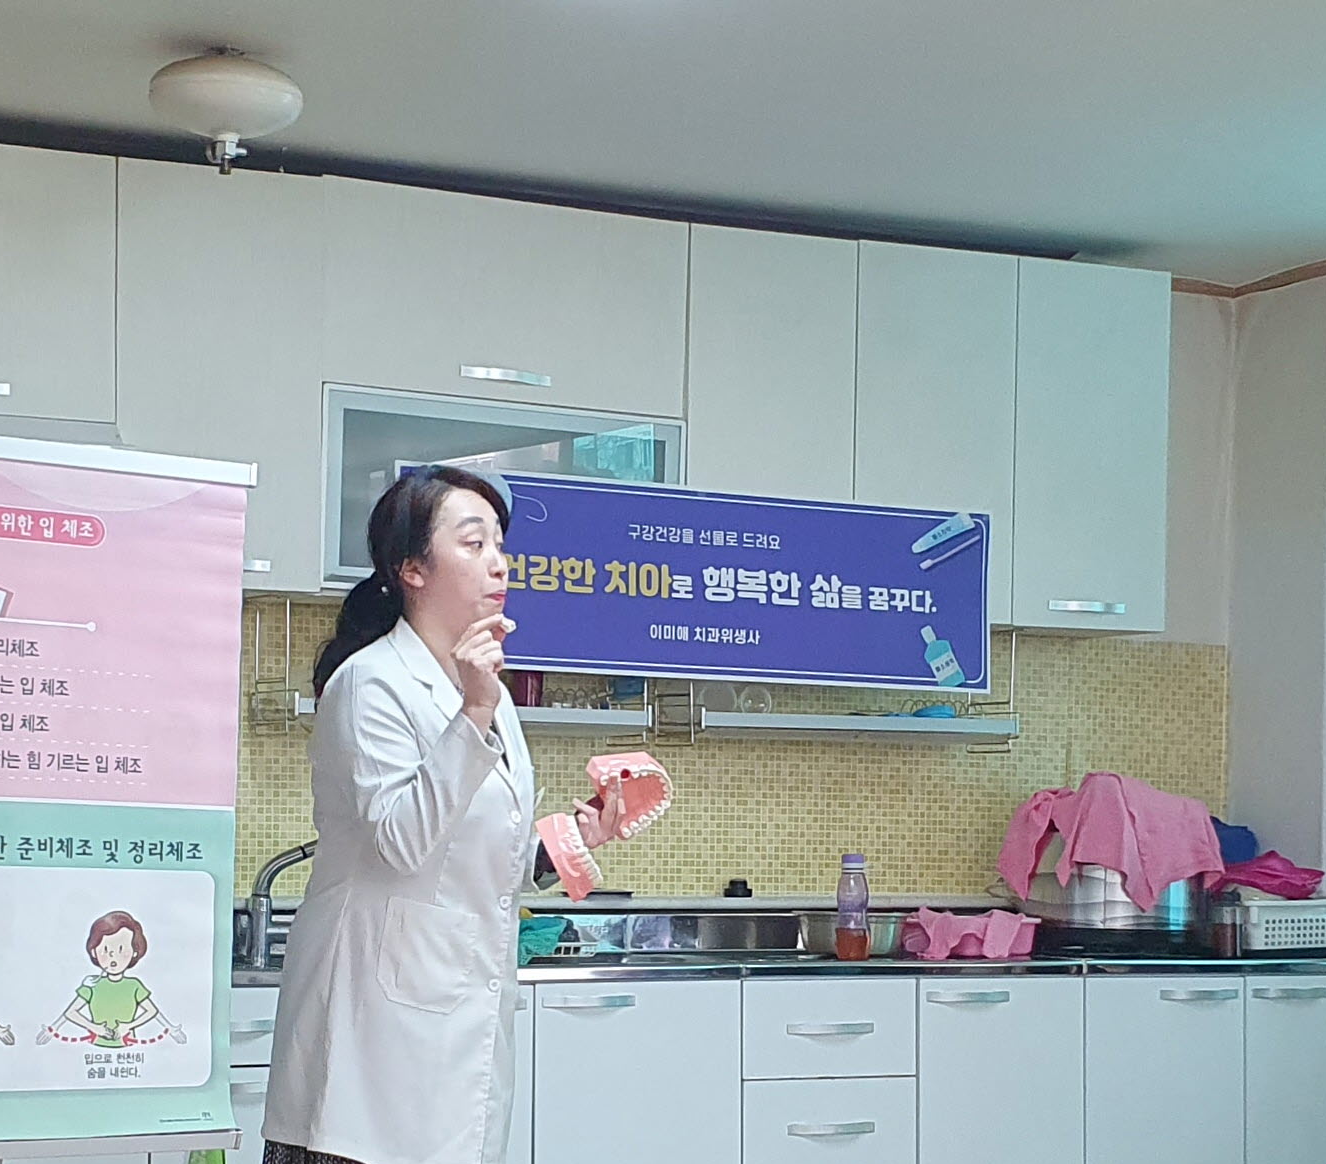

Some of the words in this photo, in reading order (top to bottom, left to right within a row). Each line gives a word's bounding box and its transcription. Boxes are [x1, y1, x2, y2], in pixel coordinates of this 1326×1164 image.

[0, 514, 33, 533] 위한
[39, 517, 54, 536] 입
[60, 519, 94, 538] 체조
[628, 524, 694, 544] 구강건강을
[699, 528, 739, 546] 선물로
[742, 531, 781, 550] 드려요
[604, 560, 693, 600] 치아로
[703, 566, 801, 605] 행복한
[811, 574, 862, 608] 삶을
[869, 586, 937, 614] 꿈꾸다.
[650, 624, 689, 643] 이미애
[694, 626, 760, 646] 치과위생사
[20, 677, 34, 696] 입
[40, 677, 70, 696] 체조
[0, 713, 14, 732] 입
[20, 714, 50, 732] 체조
[27, 752, 41, 770] 힘
[47, 753, 90, 772] 기르는
[96, 755, 109, 774] 입
[114, 755, 142, 774] 체조
[16, 836, 93, 860] 준비체조
[102, 840, 119, 862] 및
[127, 840, 203, 863] 정리체조
